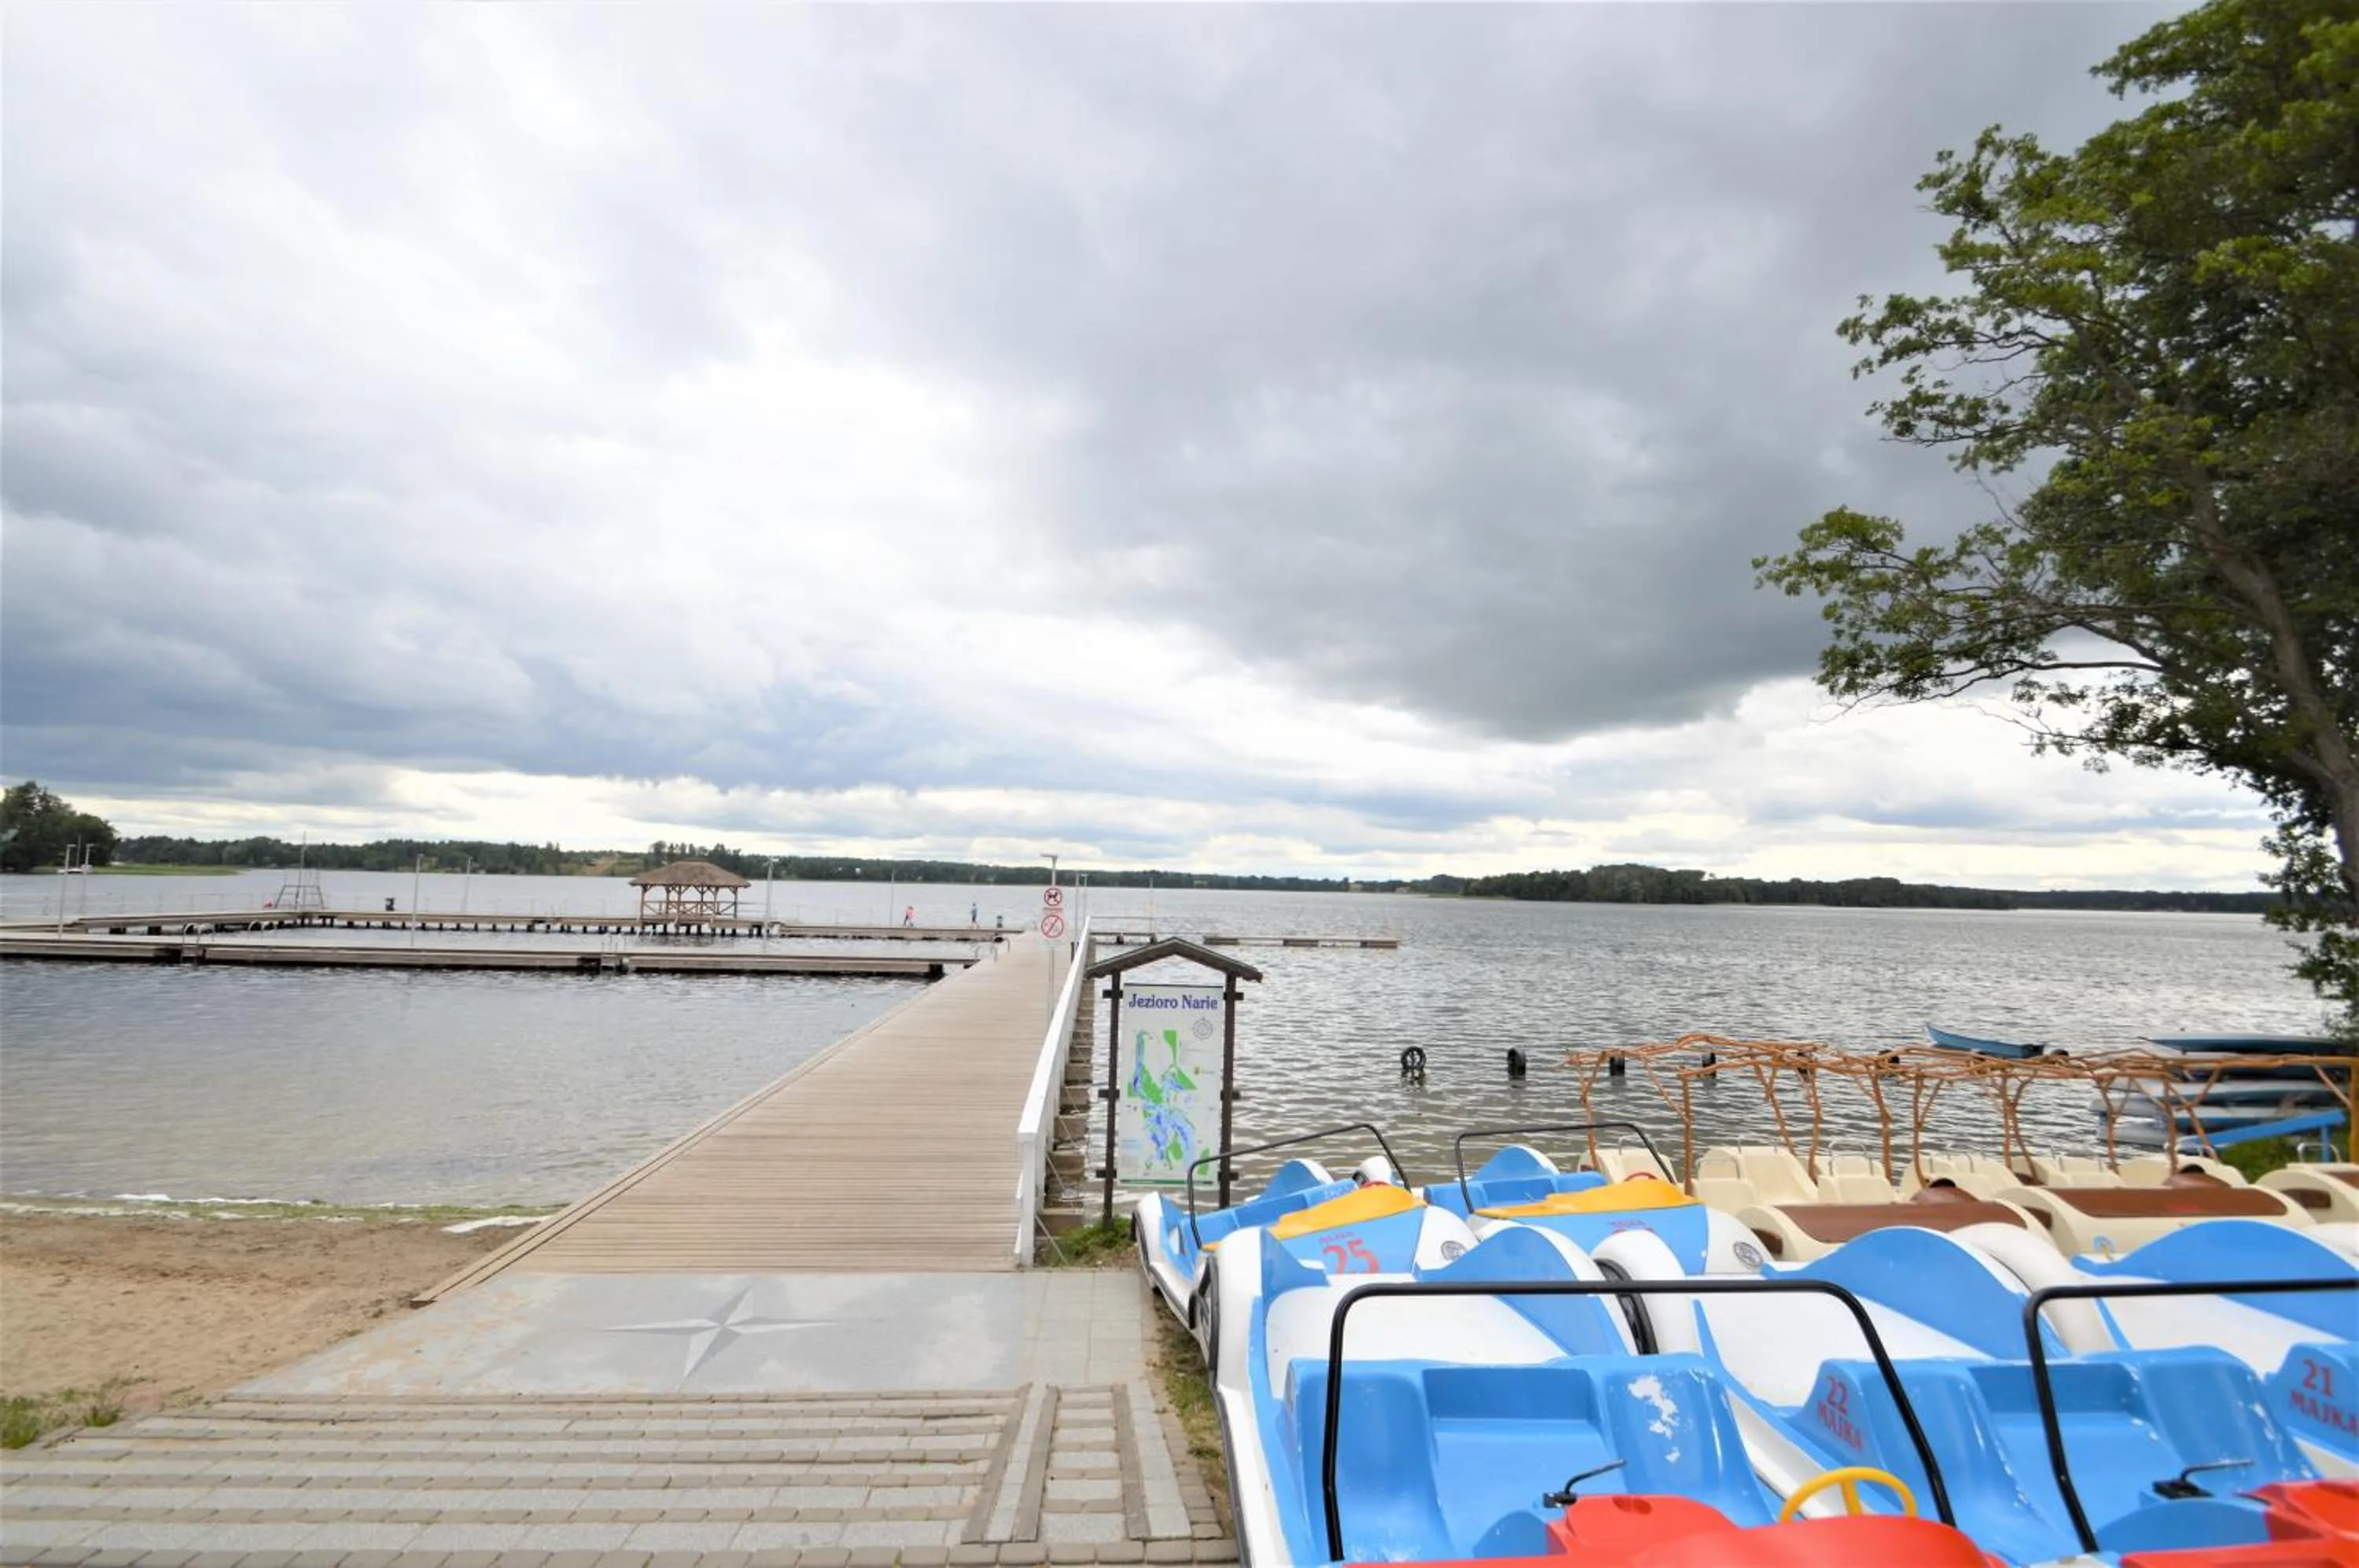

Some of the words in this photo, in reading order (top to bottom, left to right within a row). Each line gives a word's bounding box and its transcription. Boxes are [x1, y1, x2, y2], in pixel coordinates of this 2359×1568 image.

[1128, 993, 1179, 1009] Jezioro
[1182, 994, 1218, 1010] Narie
[1323, 1239, 1379, 1274] 25
[1827, 1375, 1849, 1415] 22
[2303, 1358, 2333, 1397] 21
[1817, 1401, 1864, 1452] MAJKA
